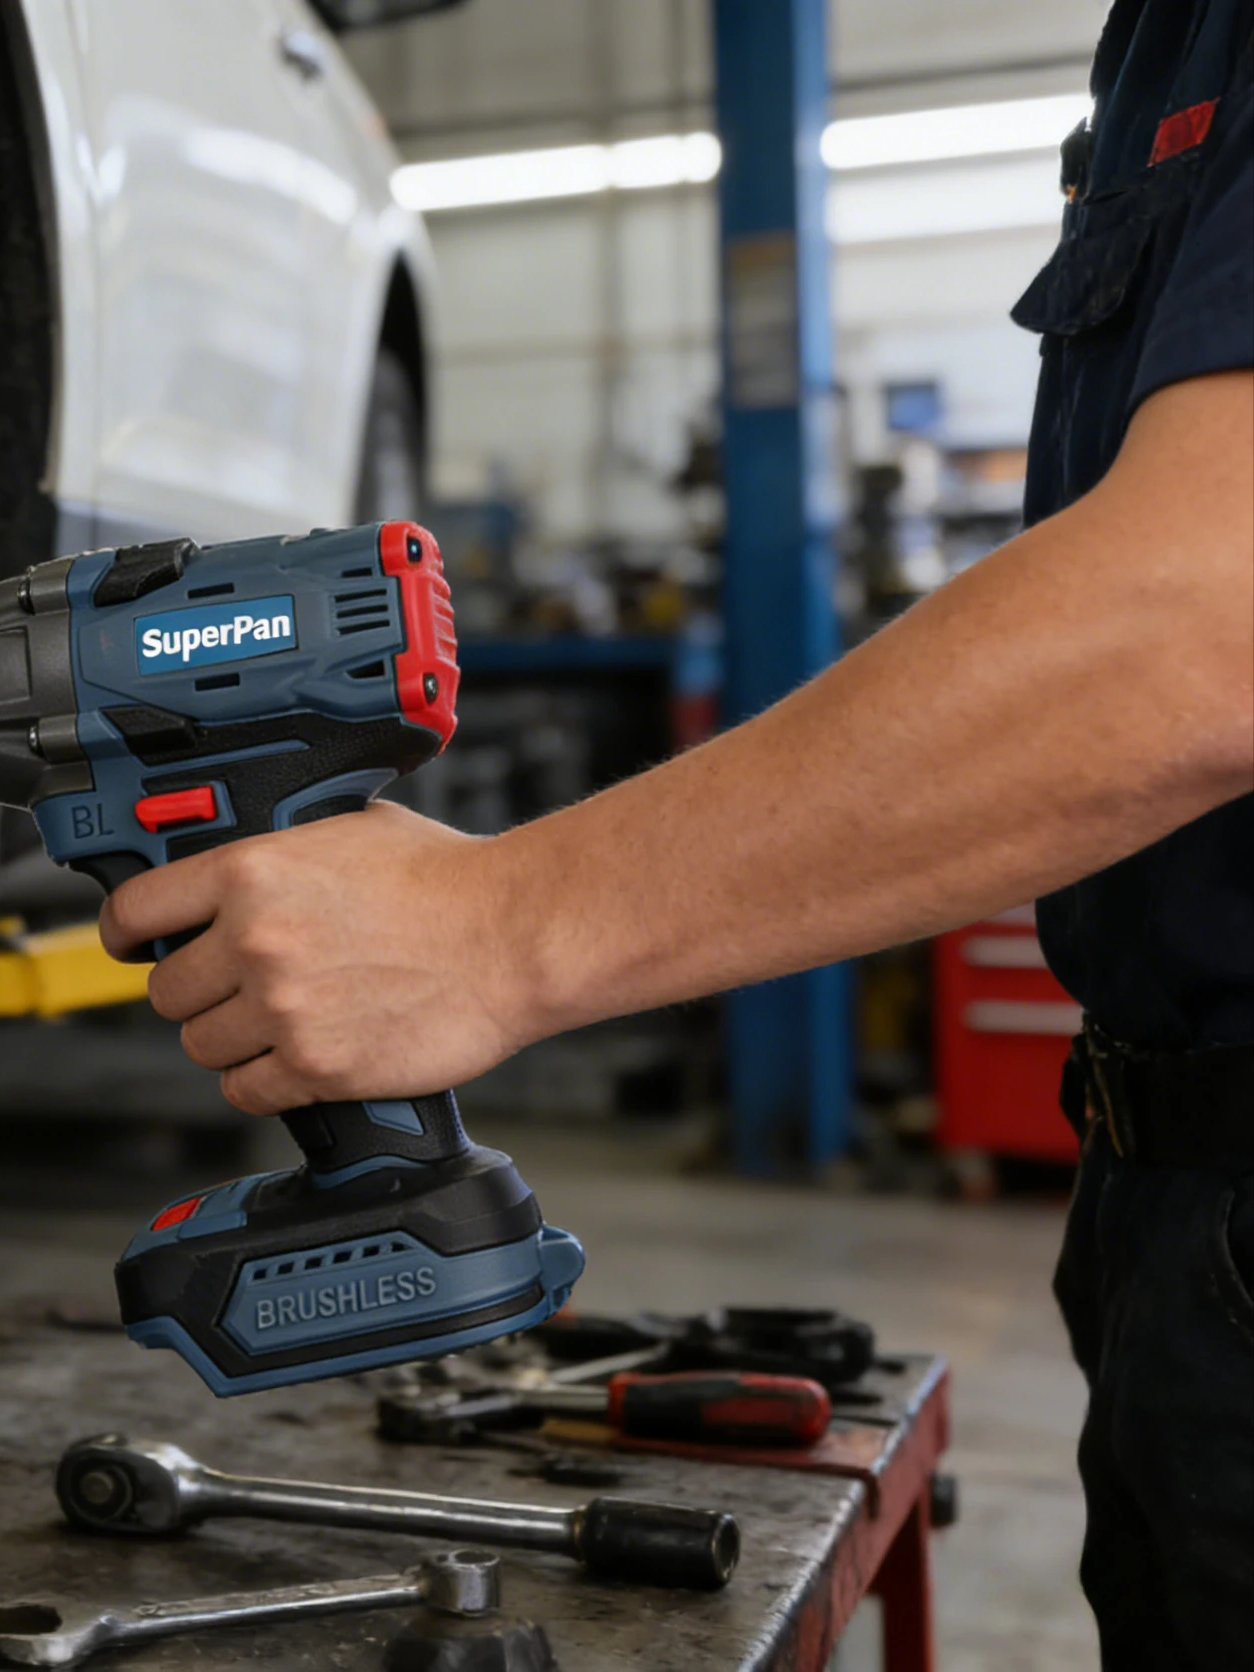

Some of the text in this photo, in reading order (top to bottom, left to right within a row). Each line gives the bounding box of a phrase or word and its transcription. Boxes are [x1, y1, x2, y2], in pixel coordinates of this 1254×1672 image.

[142, 615, 291, 662] SuperPan
[71, 803, 115, 839] BL
[257, 1266, 437, 1330] BRUSHLESS
